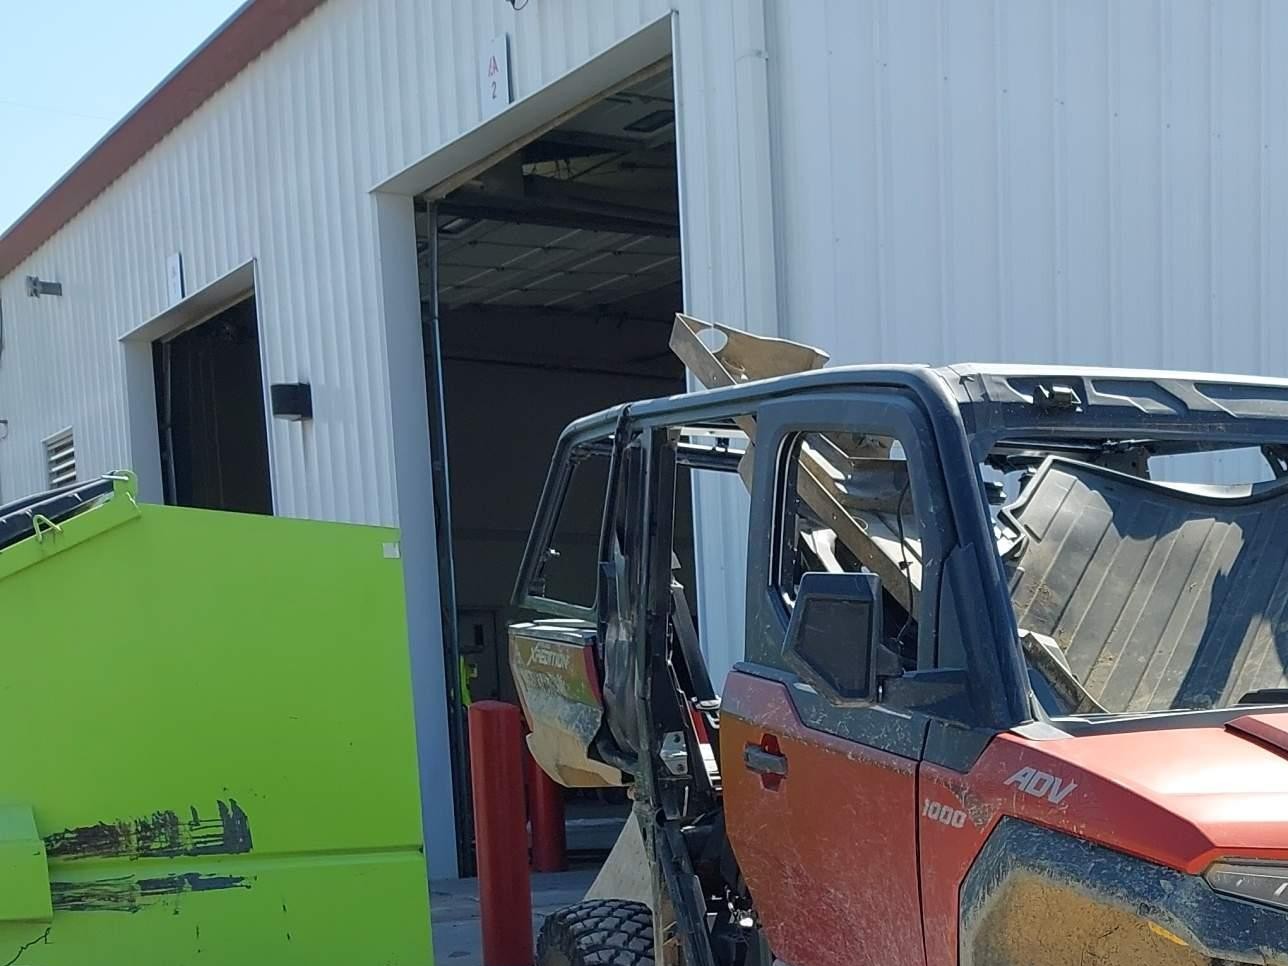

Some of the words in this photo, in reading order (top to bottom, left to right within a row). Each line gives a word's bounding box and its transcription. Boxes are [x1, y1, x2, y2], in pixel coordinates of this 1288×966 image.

[491, 80, 497, 99] 2
[1003, 766, 1078, 805] ADV
[922, 798, 968, 829] 1000
